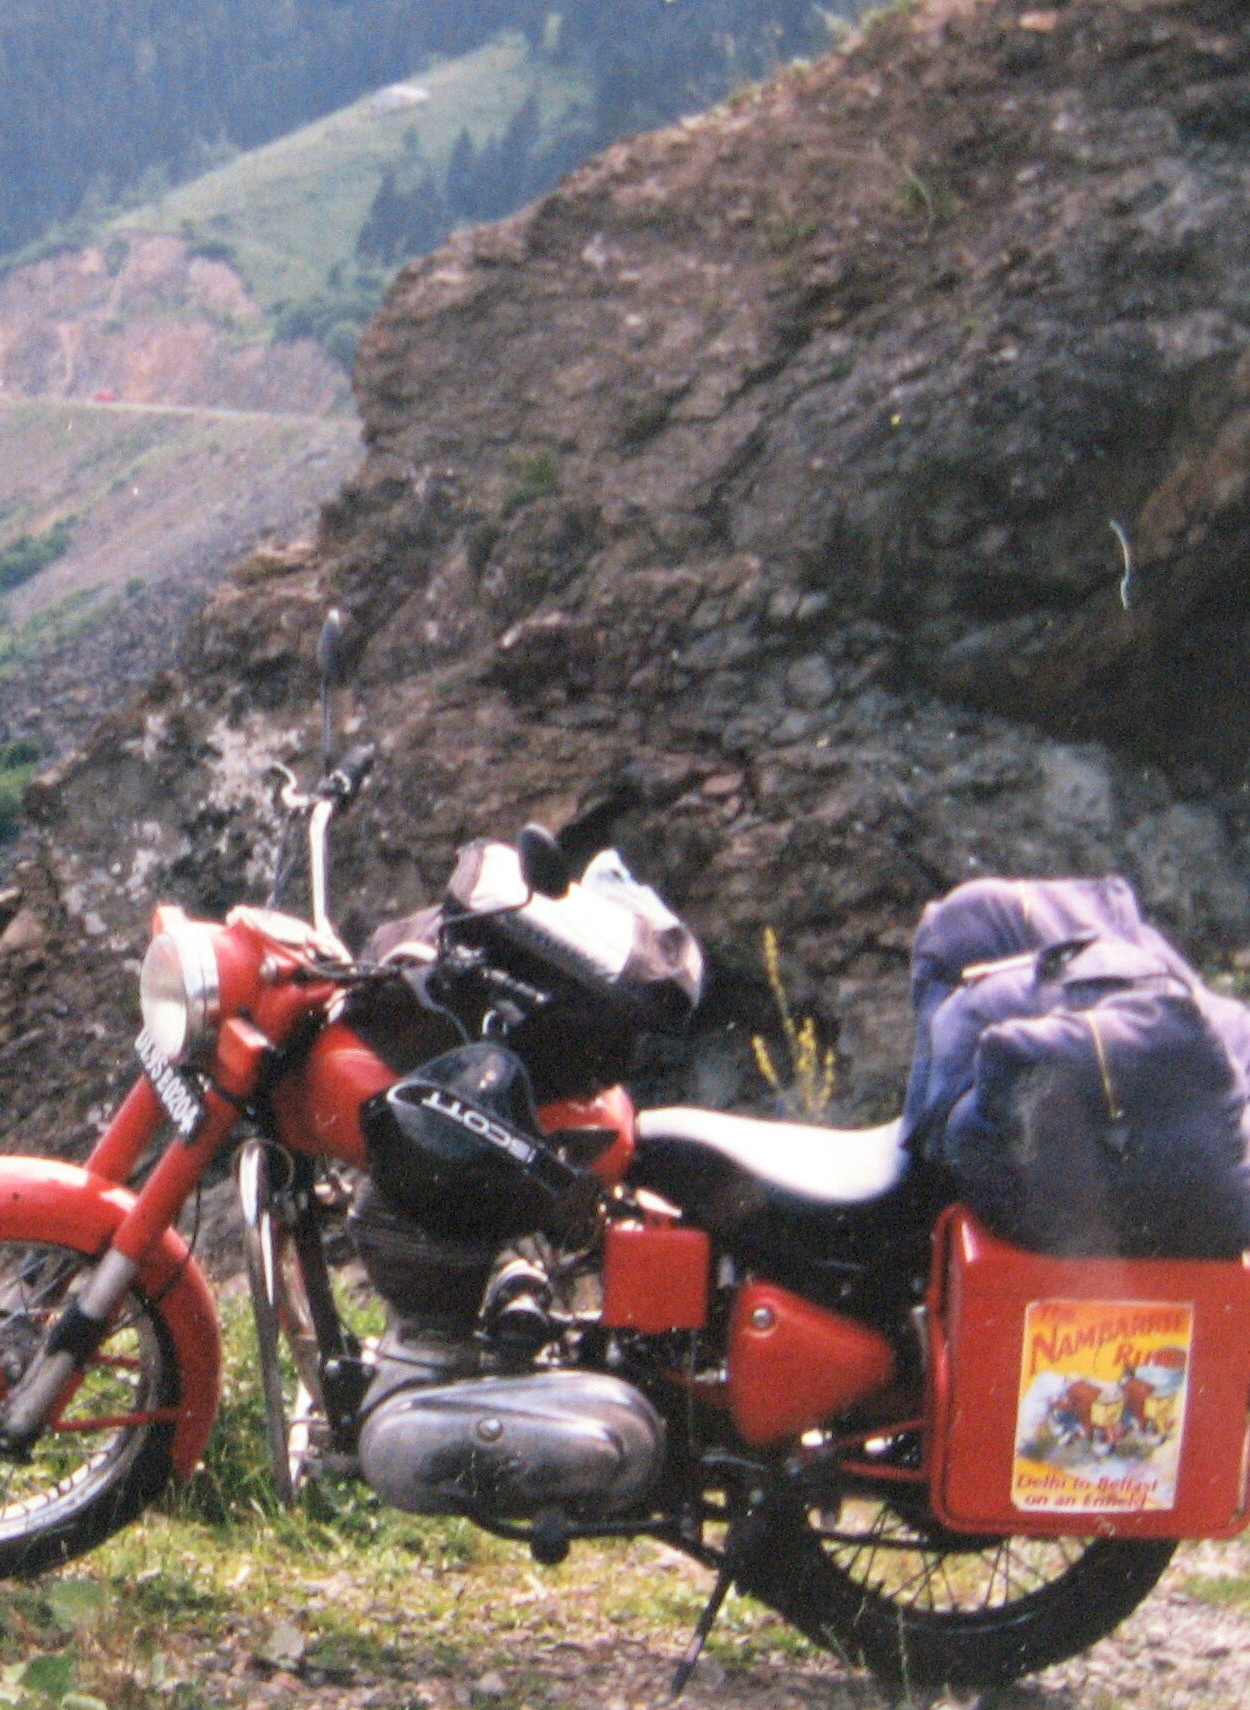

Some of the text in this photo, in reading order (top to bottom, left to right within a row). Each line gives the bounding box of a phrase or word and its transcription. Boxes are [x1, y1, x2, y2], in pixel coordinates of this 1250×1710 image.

[1016, 1473, 1158, 1492] Delhi to Belfast
[1025, 1494, 1049, 1506] on
[1055, 1494, 1077, 1507] an
